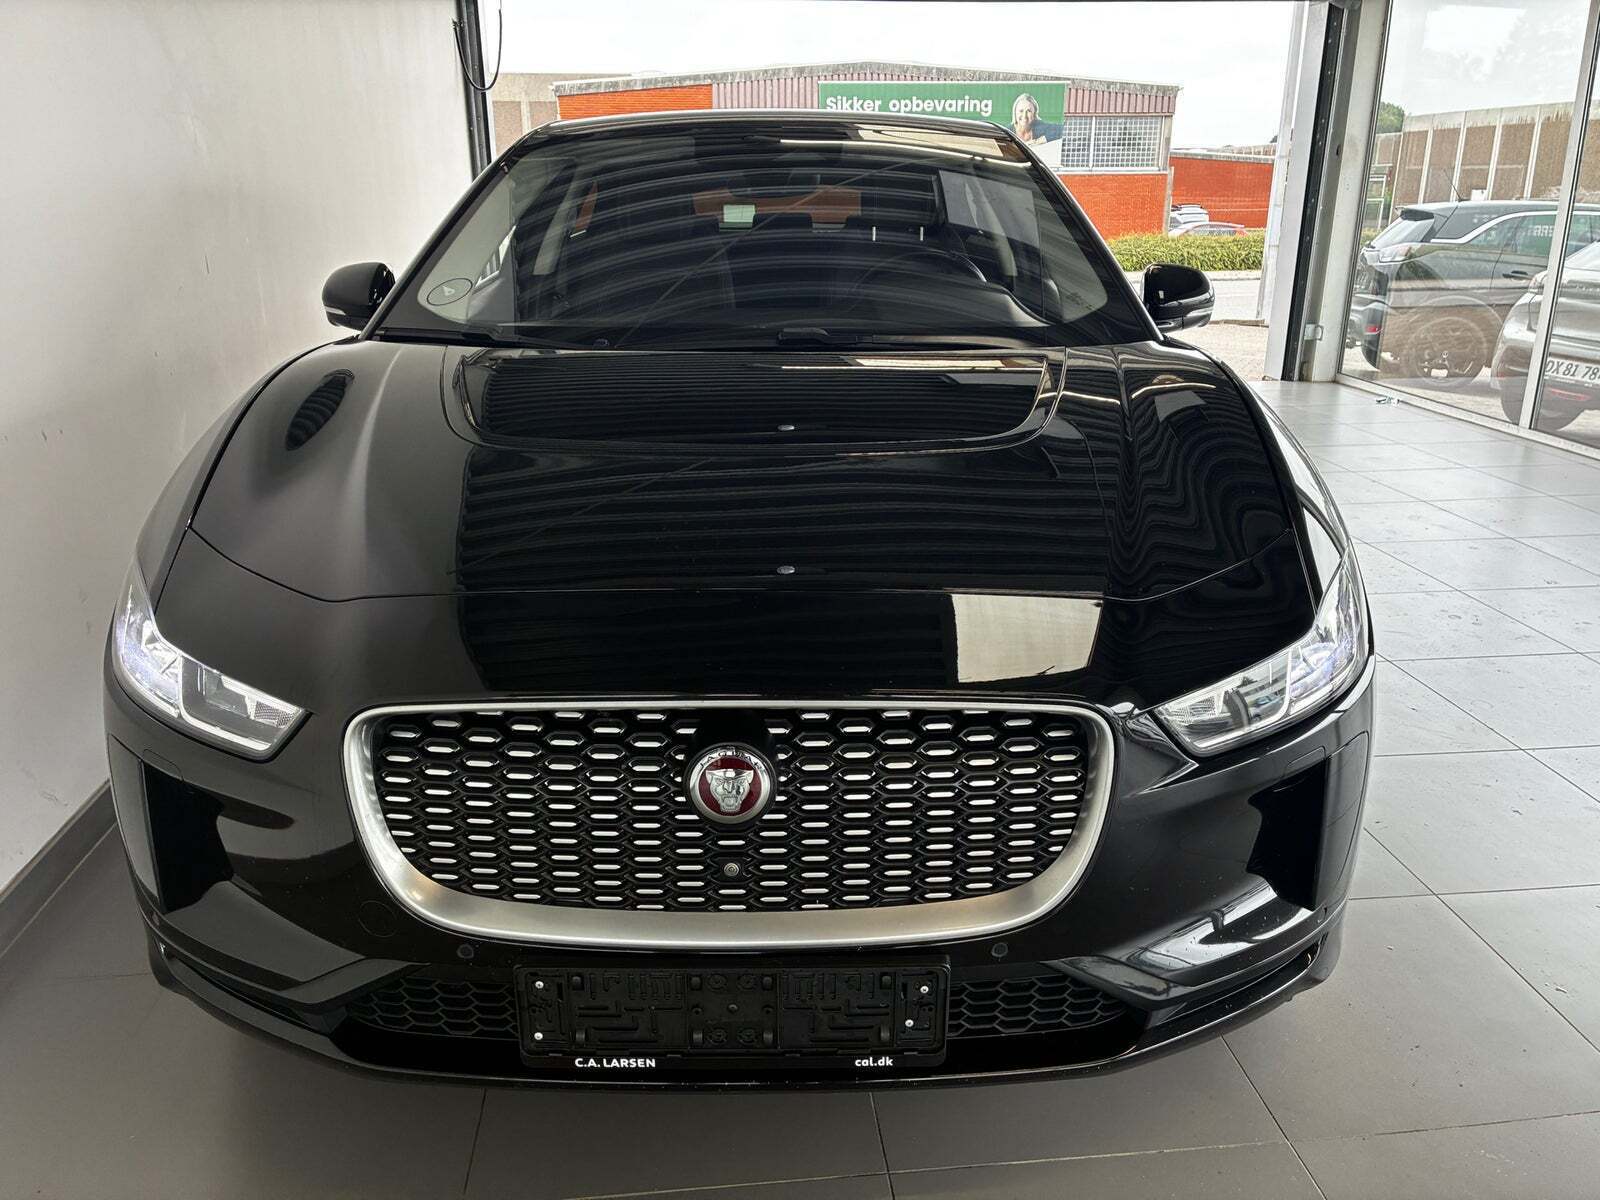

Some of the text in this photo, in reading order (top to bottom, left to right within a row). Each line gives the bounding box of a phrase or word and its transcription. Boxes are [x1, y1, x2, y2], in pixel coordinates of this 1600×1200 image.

[825, 96, 993, 116] Sikker opbevaring
[1562, 362, 1579, 376] 81
[1581, 365, 1600, 381] 78
[574, 1057, 656, 1068] C.A. LARSEN
[854, 1056, 894, 1067] cal.dk
